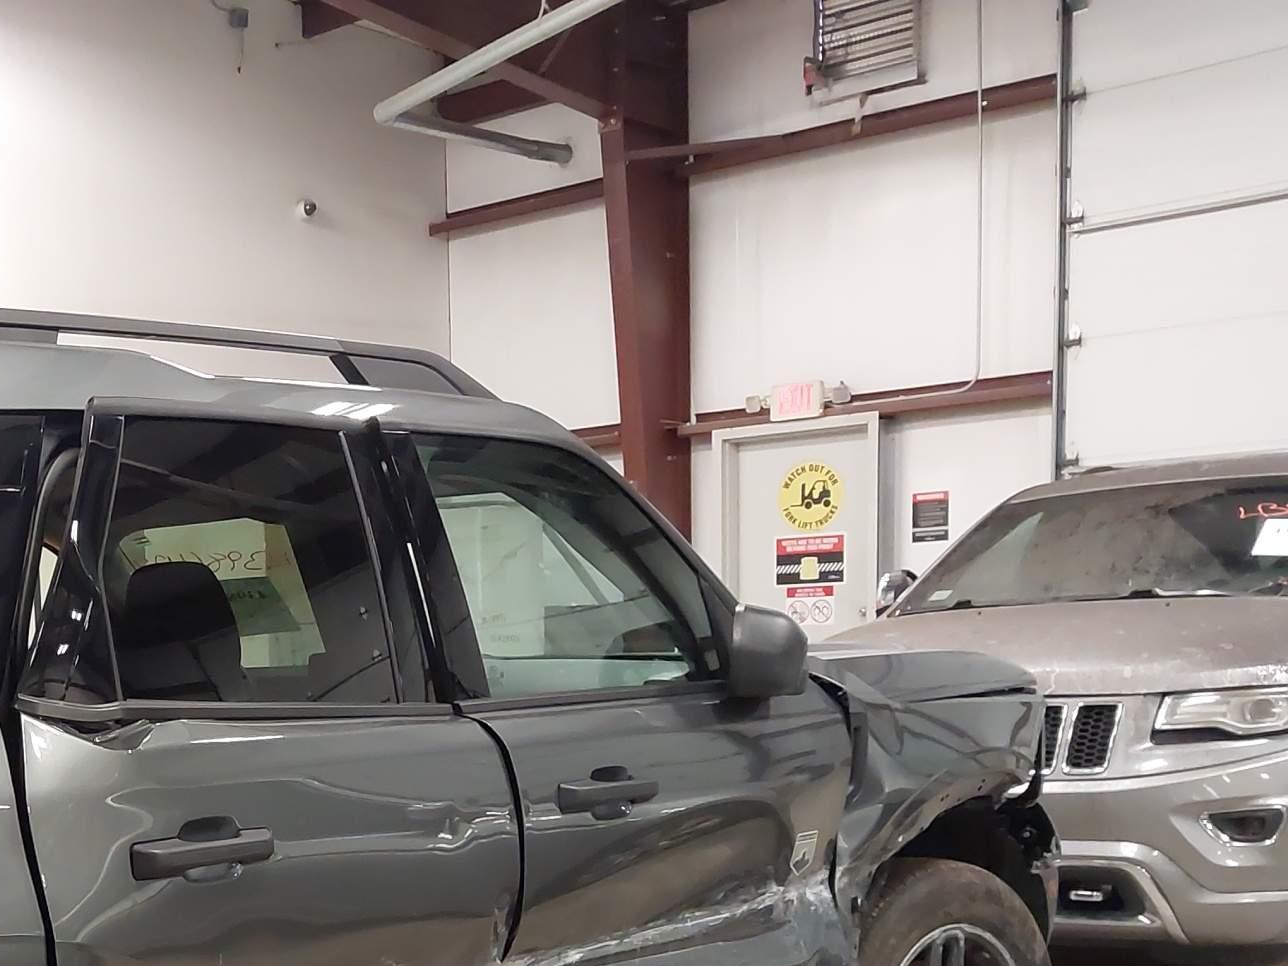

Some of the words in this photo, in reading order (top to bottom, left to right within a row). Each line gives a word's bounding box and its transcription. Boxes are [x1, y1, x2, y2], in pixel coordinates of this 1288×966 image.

[783, 465, 806, 489] WATCH
[808, 464, 825, 474] OUT
[825, 470, 839, 486] FOR
[783, 507, 798, 525] FORK
[798, 519, 813, 529] LIFT
[814, 504, 839, 528] TRUCKS
